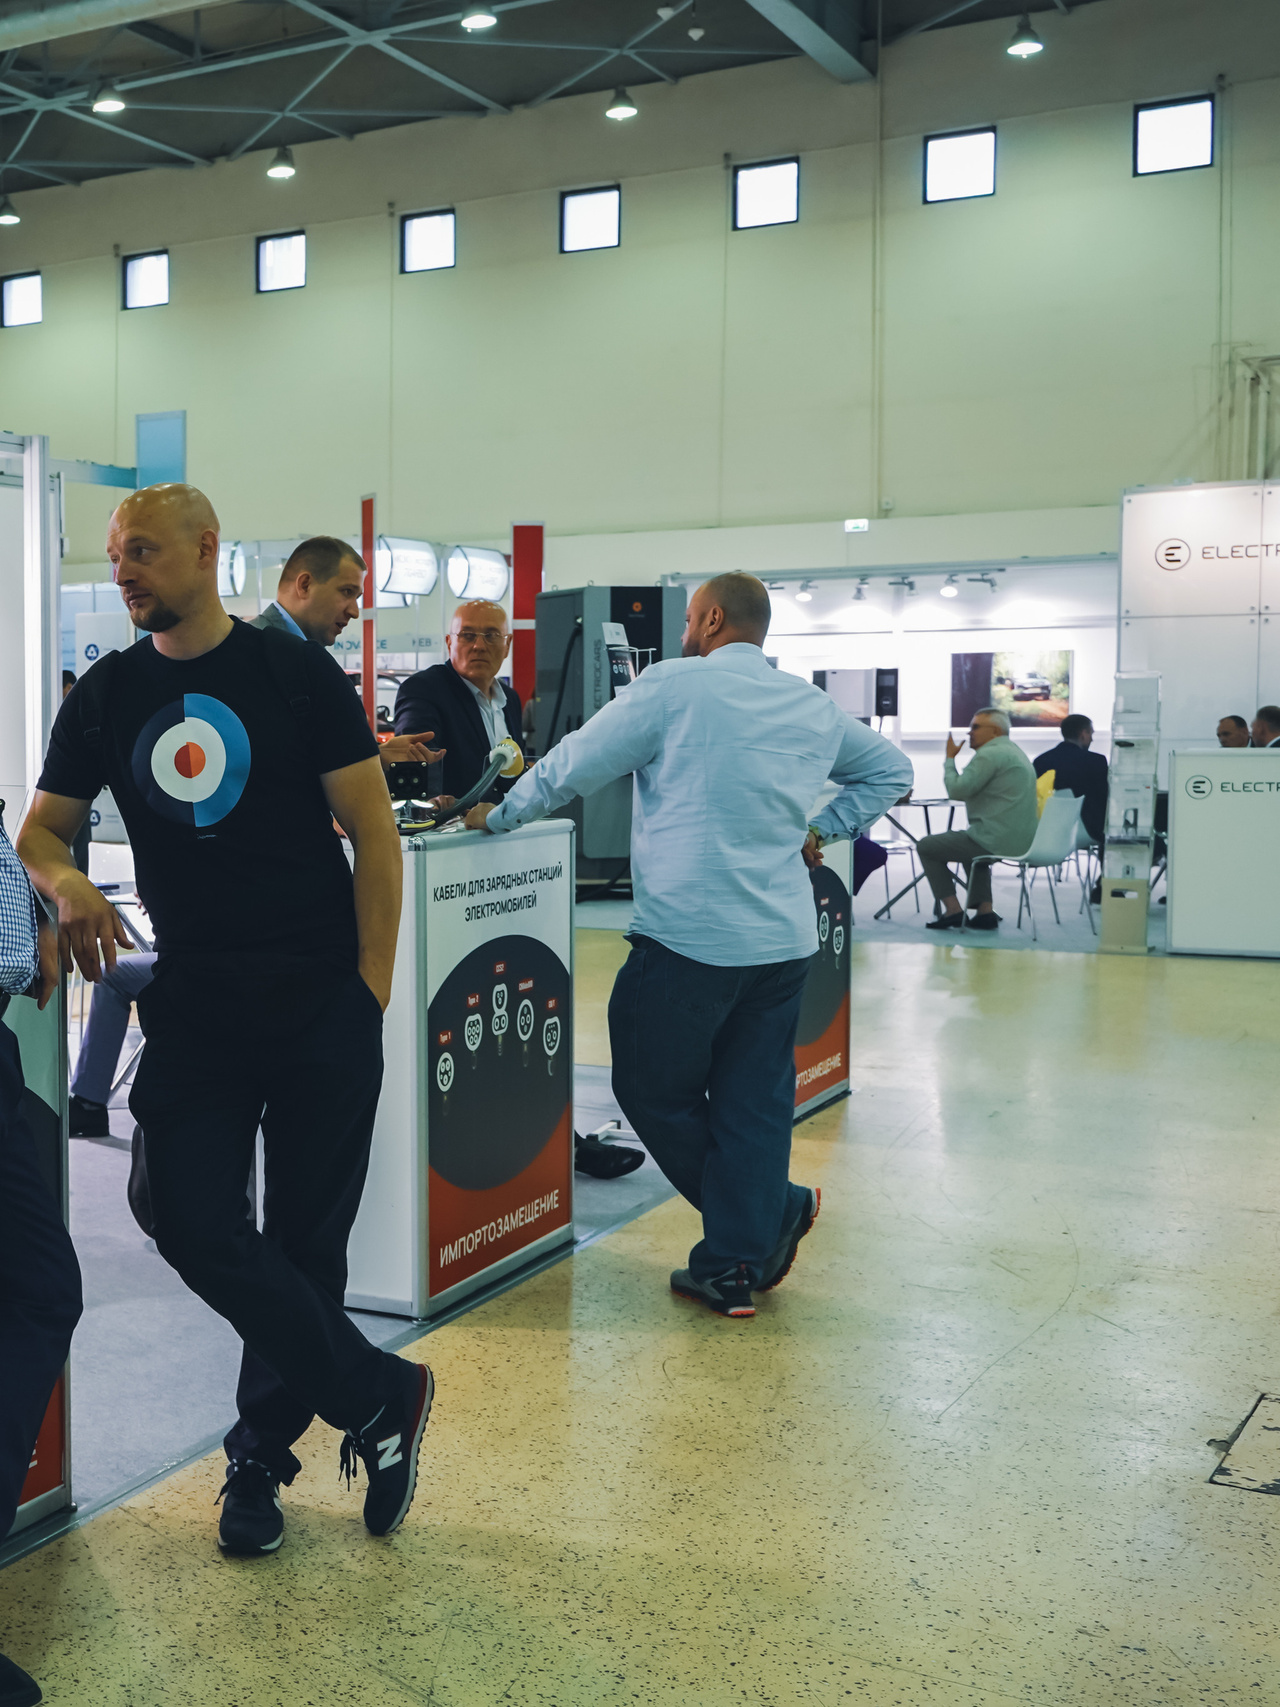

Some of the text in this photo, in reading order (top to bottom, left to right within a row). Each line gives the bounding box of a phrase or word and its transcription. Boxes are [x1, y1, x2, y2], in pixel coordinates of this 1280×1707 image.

[433, 861, 563, 902] КАБЕЛИ ДЛЯ ЗАРЯДНЫХ СТАНЦИЙ
[464, 890, 537, 922] ЭЛЕКТРОМОБИЛЕЙ
[440, 1189, 560, 1269] ИМПОРТОЗАМЕЩЕНИЕ
